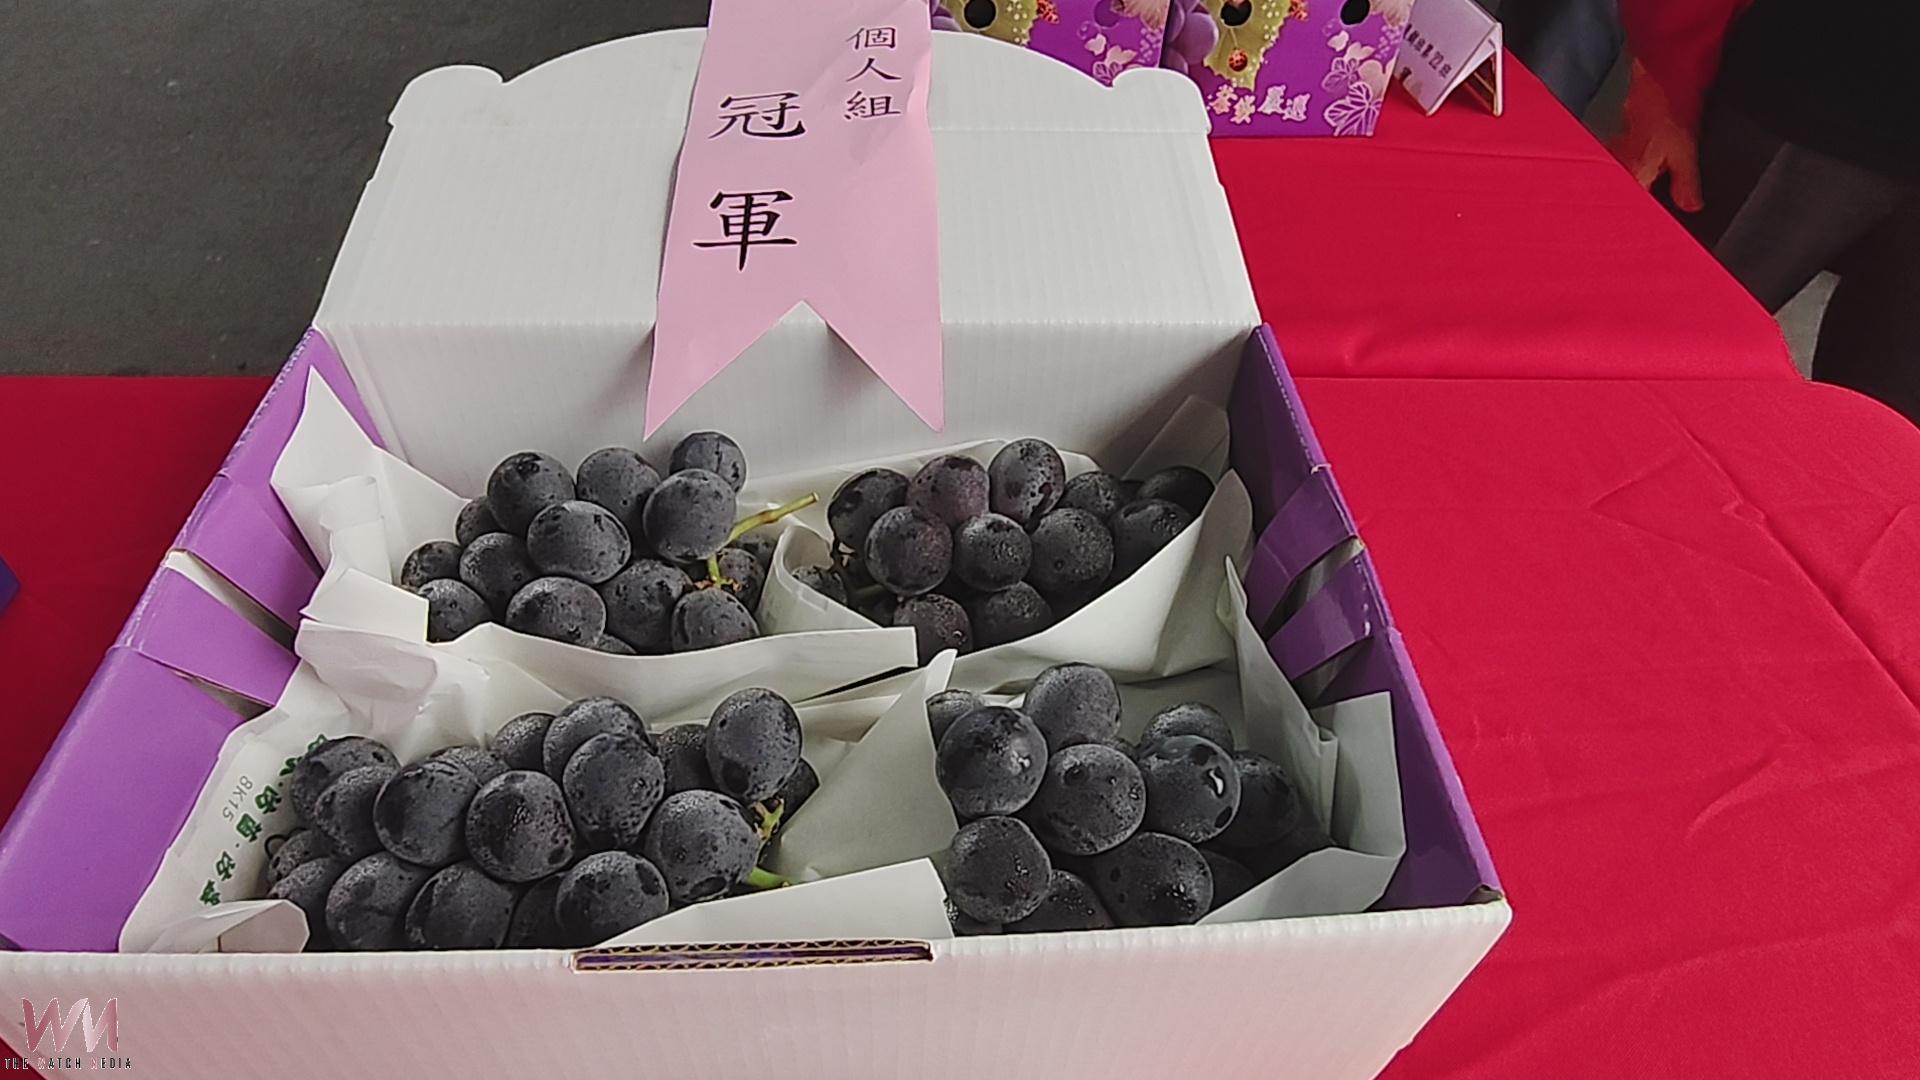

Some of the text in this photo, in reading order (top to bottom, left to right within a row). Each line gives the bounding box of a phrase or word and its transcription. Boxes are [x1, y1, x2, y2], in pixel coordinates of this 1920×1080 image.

[844, 26, 902, 121] 個人組
[692, 92, 806, 272] 冠軍
[222, 775, 253, 822] 8K15
